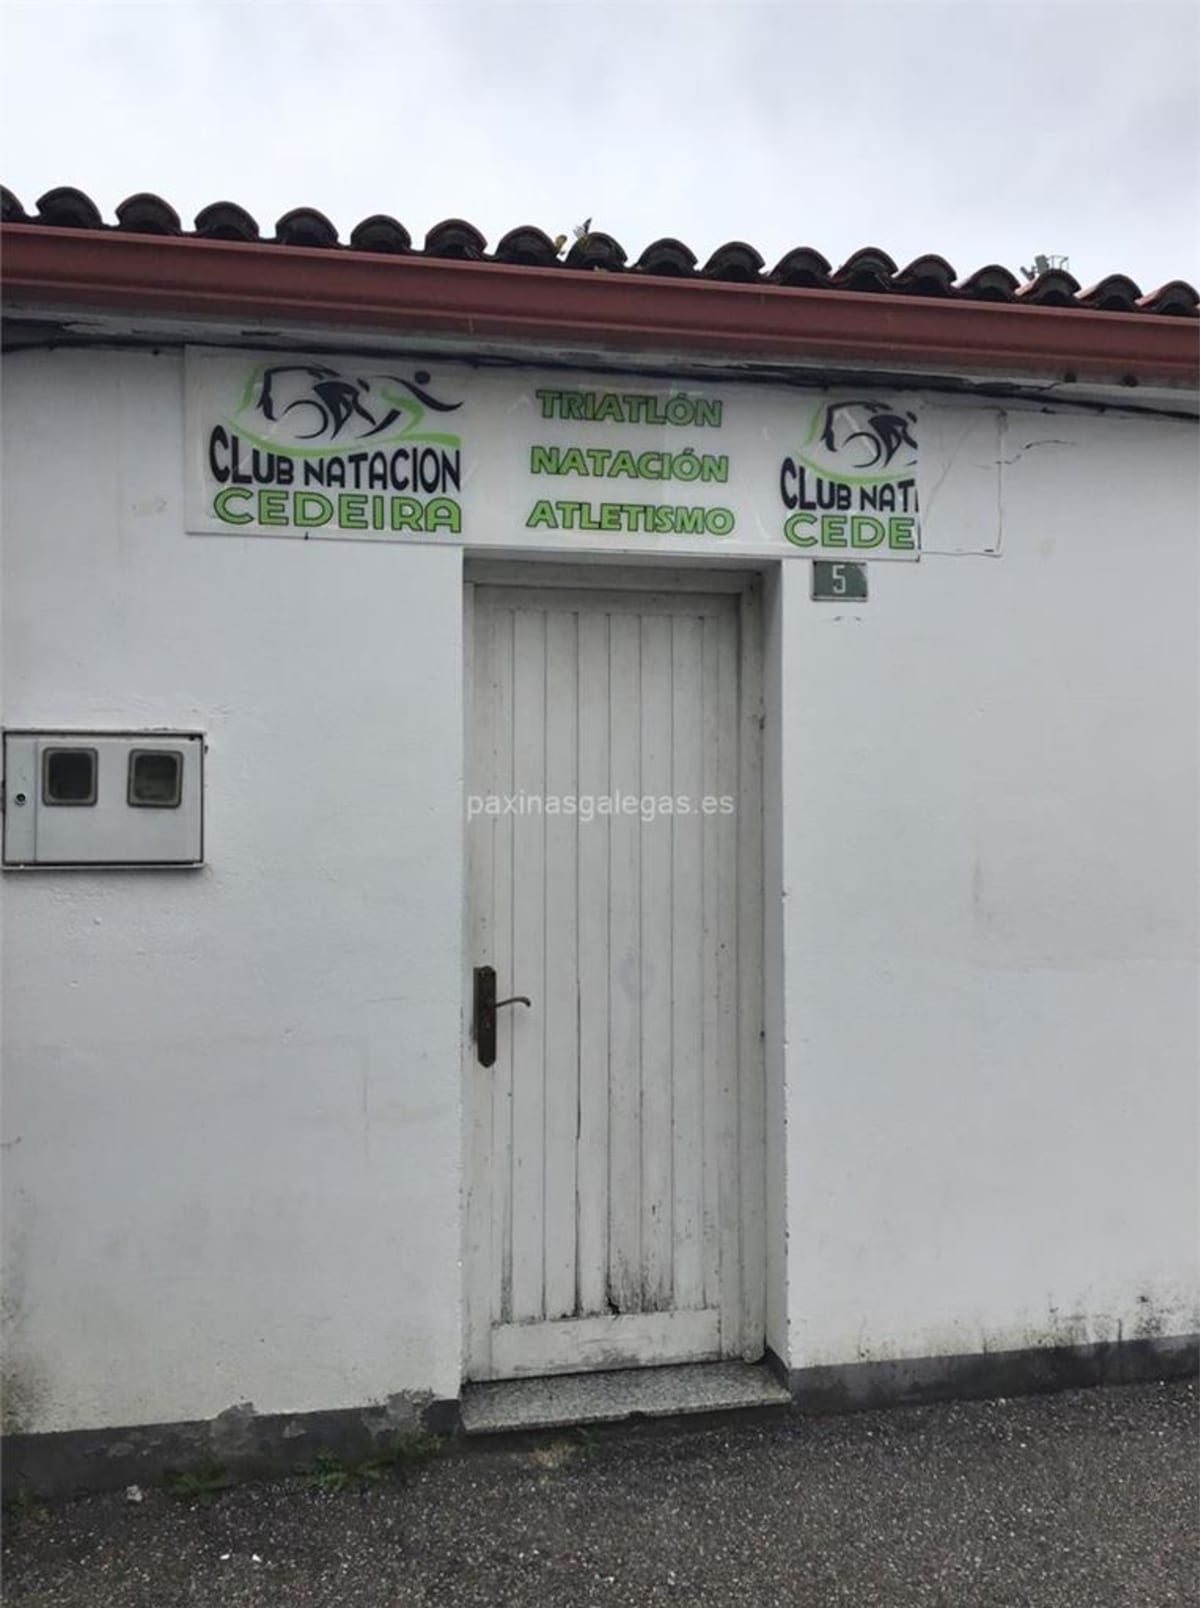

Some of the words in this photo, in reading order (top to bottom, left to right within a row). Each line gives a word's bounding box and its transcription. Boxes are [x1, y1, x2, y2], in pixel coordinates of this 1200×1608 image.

[535, 388, 723, 428] TRIATLÓN
[209, 424, 294, 485] CLUB
[304, 447, 461, 493] NATACION
[530, 445, 729, 483] NATACIÓN
[780, 456, 852, 511] CLUB
[860, 478, 919, 513] NAT
[213, 486, 462, 533] CEDEIRA
[525, 500, 735, 536] ATLETISMO
[783, 512, 915, 550] CEDE
[832, 564, 847, 594] 5
